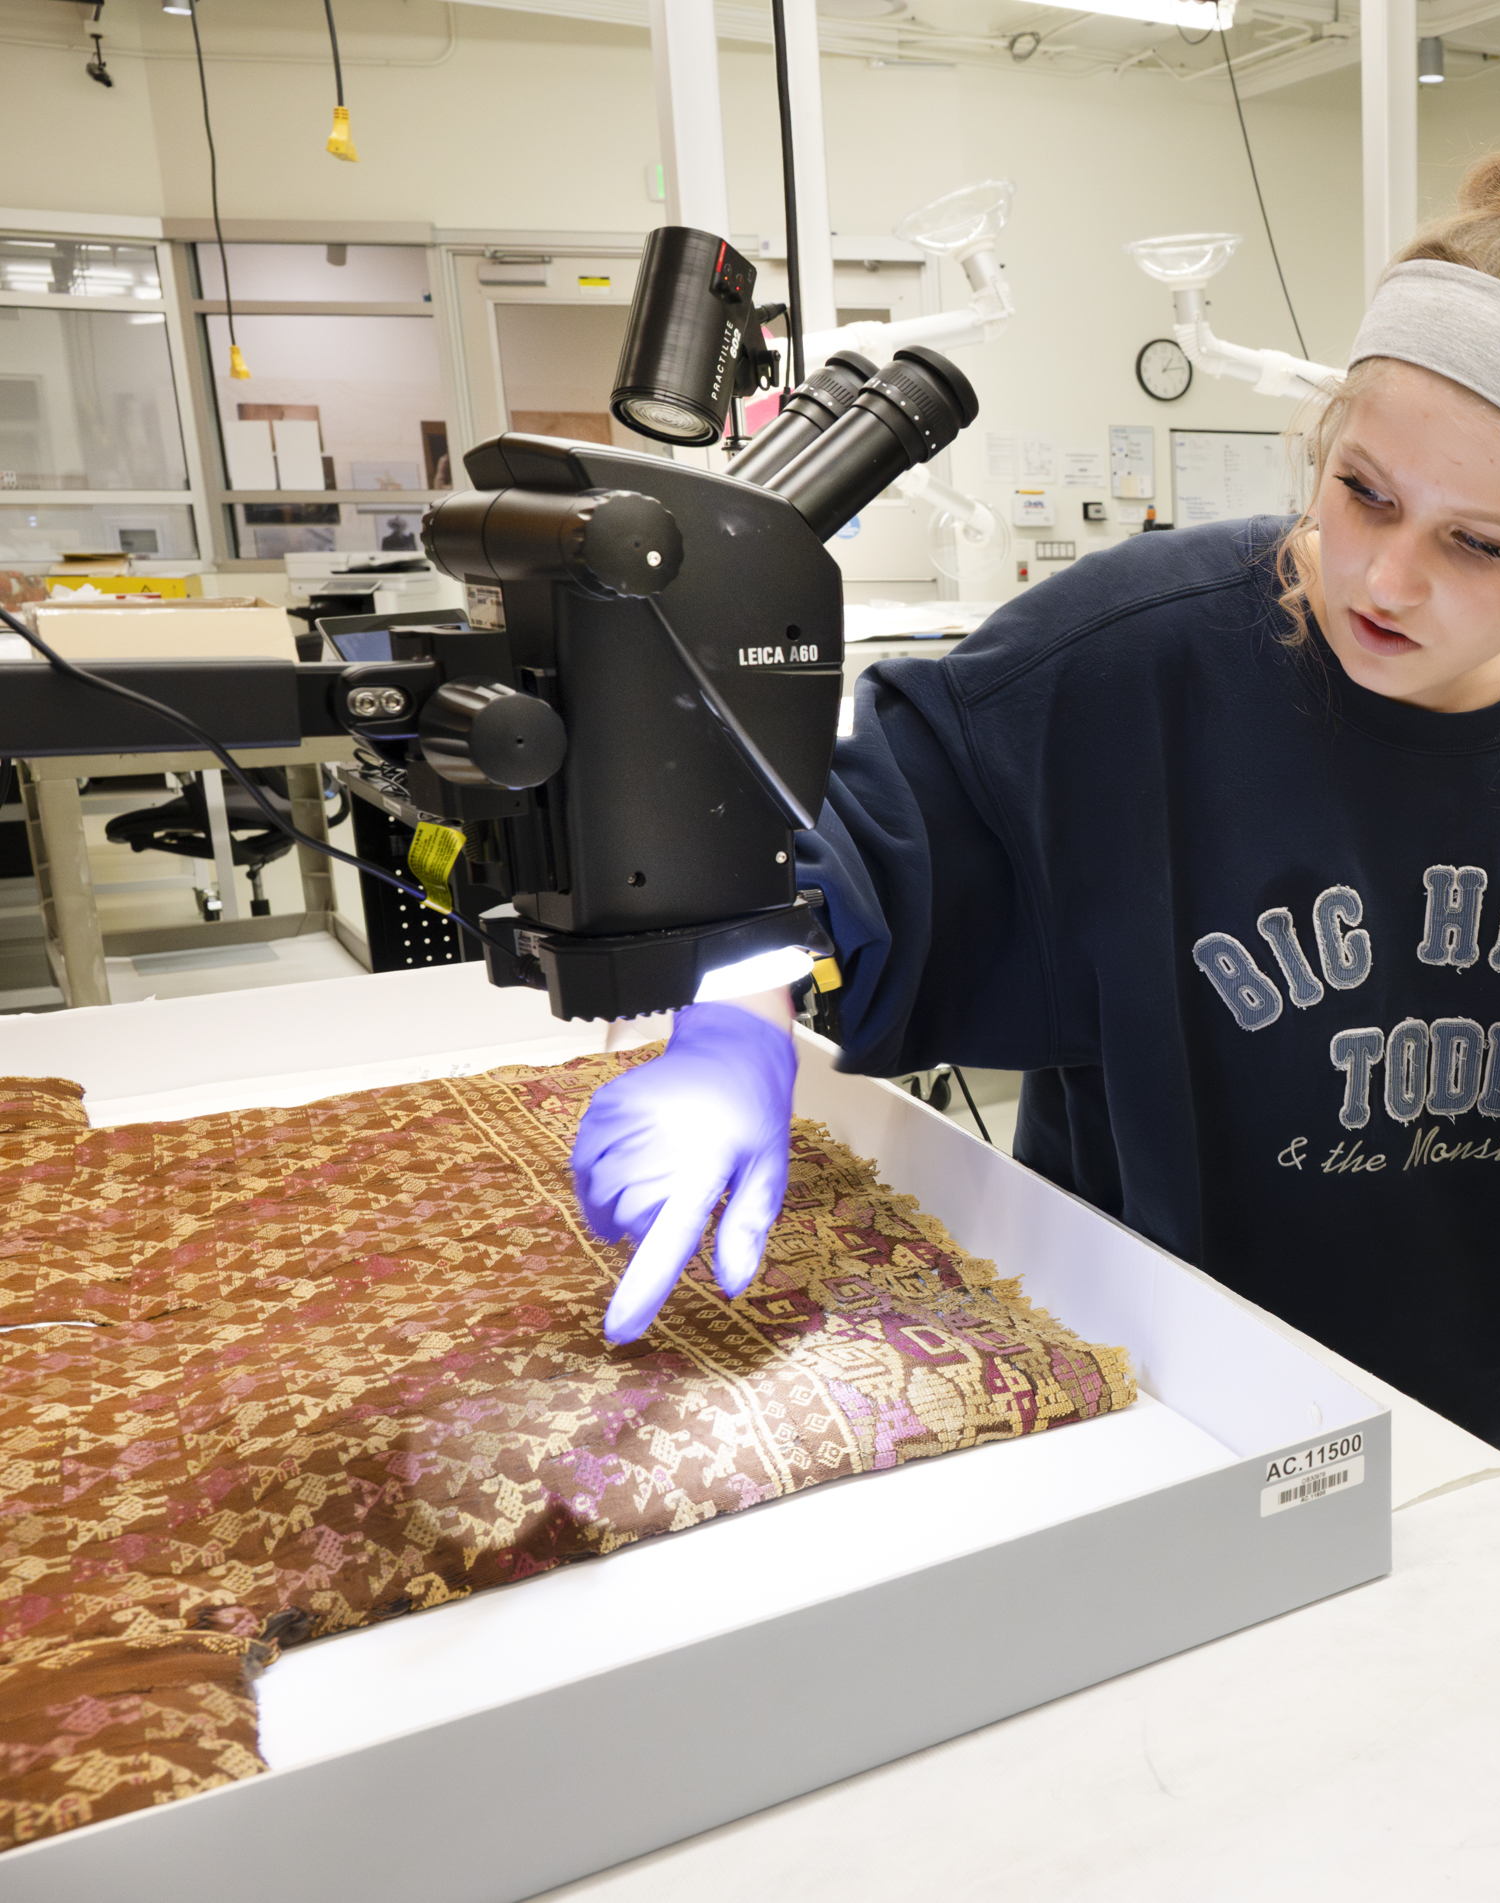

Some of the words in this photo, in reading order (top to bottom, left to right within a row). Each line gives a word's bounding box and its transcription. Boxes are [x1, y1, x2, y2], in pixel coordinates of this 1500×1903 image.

[711, 320, 734, 401] PRACTILITE
[730, 328, 741, 359] 602
[739, 646, 785, 666] LEICA
[789, 644, 818, 662] A60
[1192, 884, 1373, 1032] BIG
[1277, 1136, 1308, 1170] &
[1322, 1140, 1387, 1174] the
[1266, 1434, 1362, 1483] AC.11500
